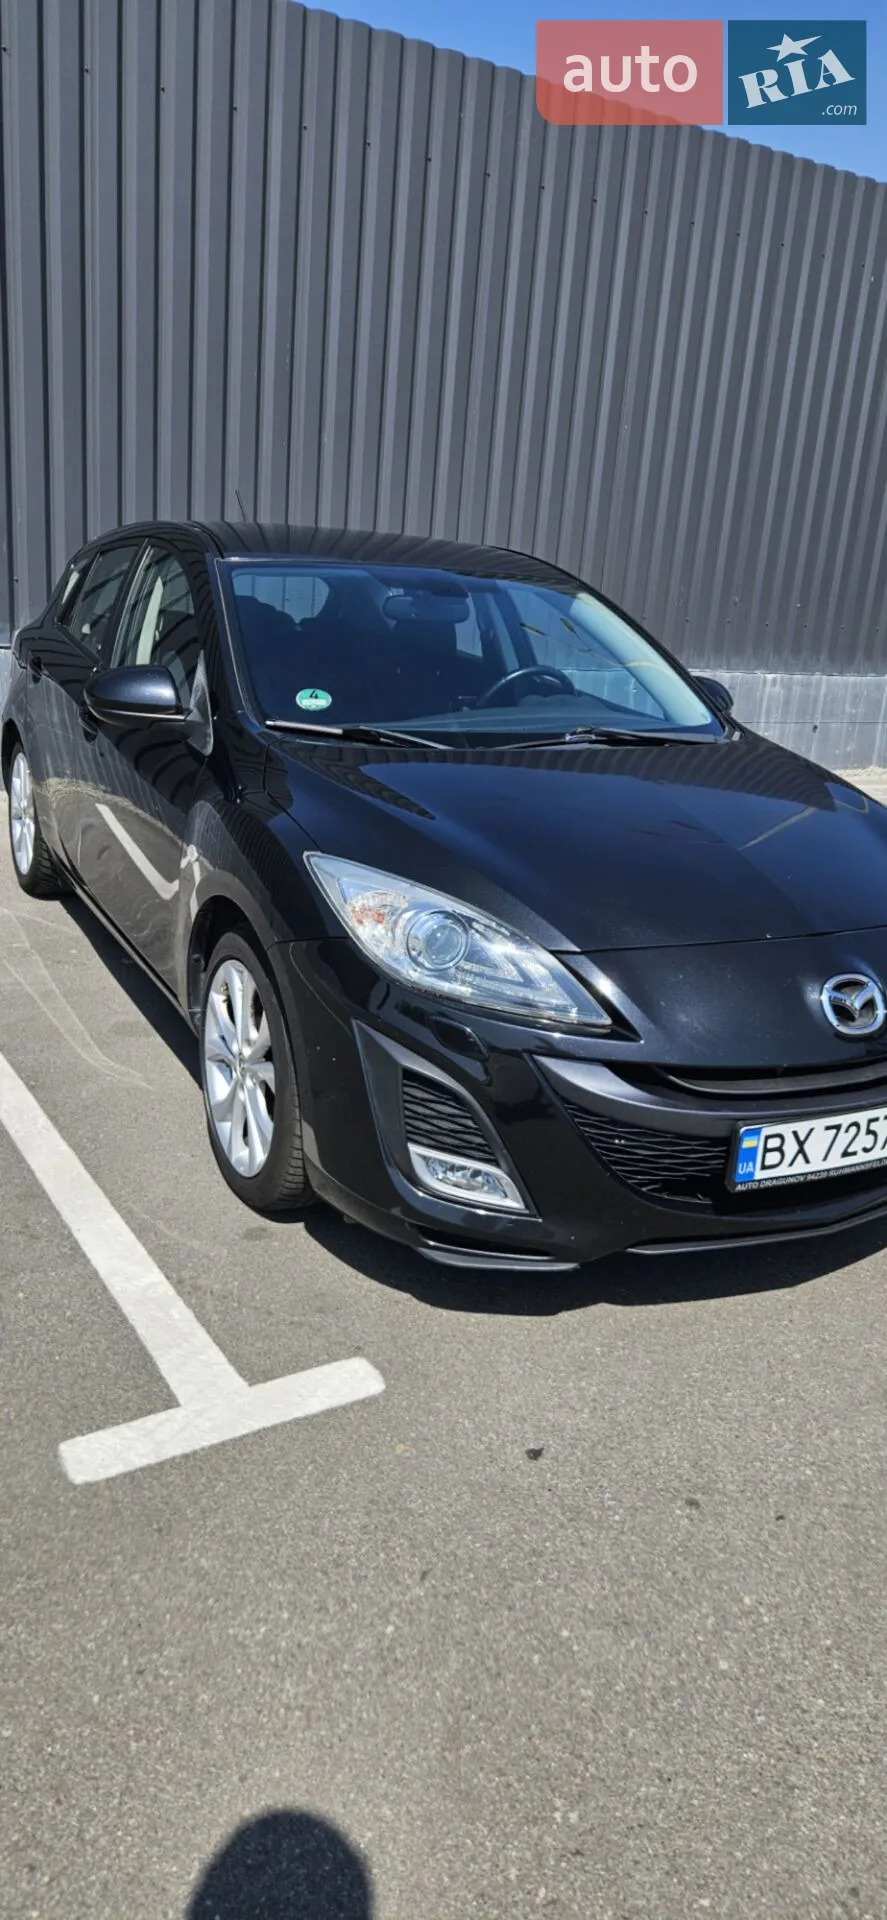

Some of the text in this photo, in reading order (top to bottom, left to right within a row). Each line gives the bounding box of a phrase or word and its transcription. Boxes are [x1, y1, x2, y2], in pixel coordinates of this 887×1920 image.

[759, 1126, 815, 1171] BX
[738, 1162, 754, 1175] UA
[735, 1181, 759, 1192] AUTO
[760, 1173, 806, 1189] DRAGUNOV
